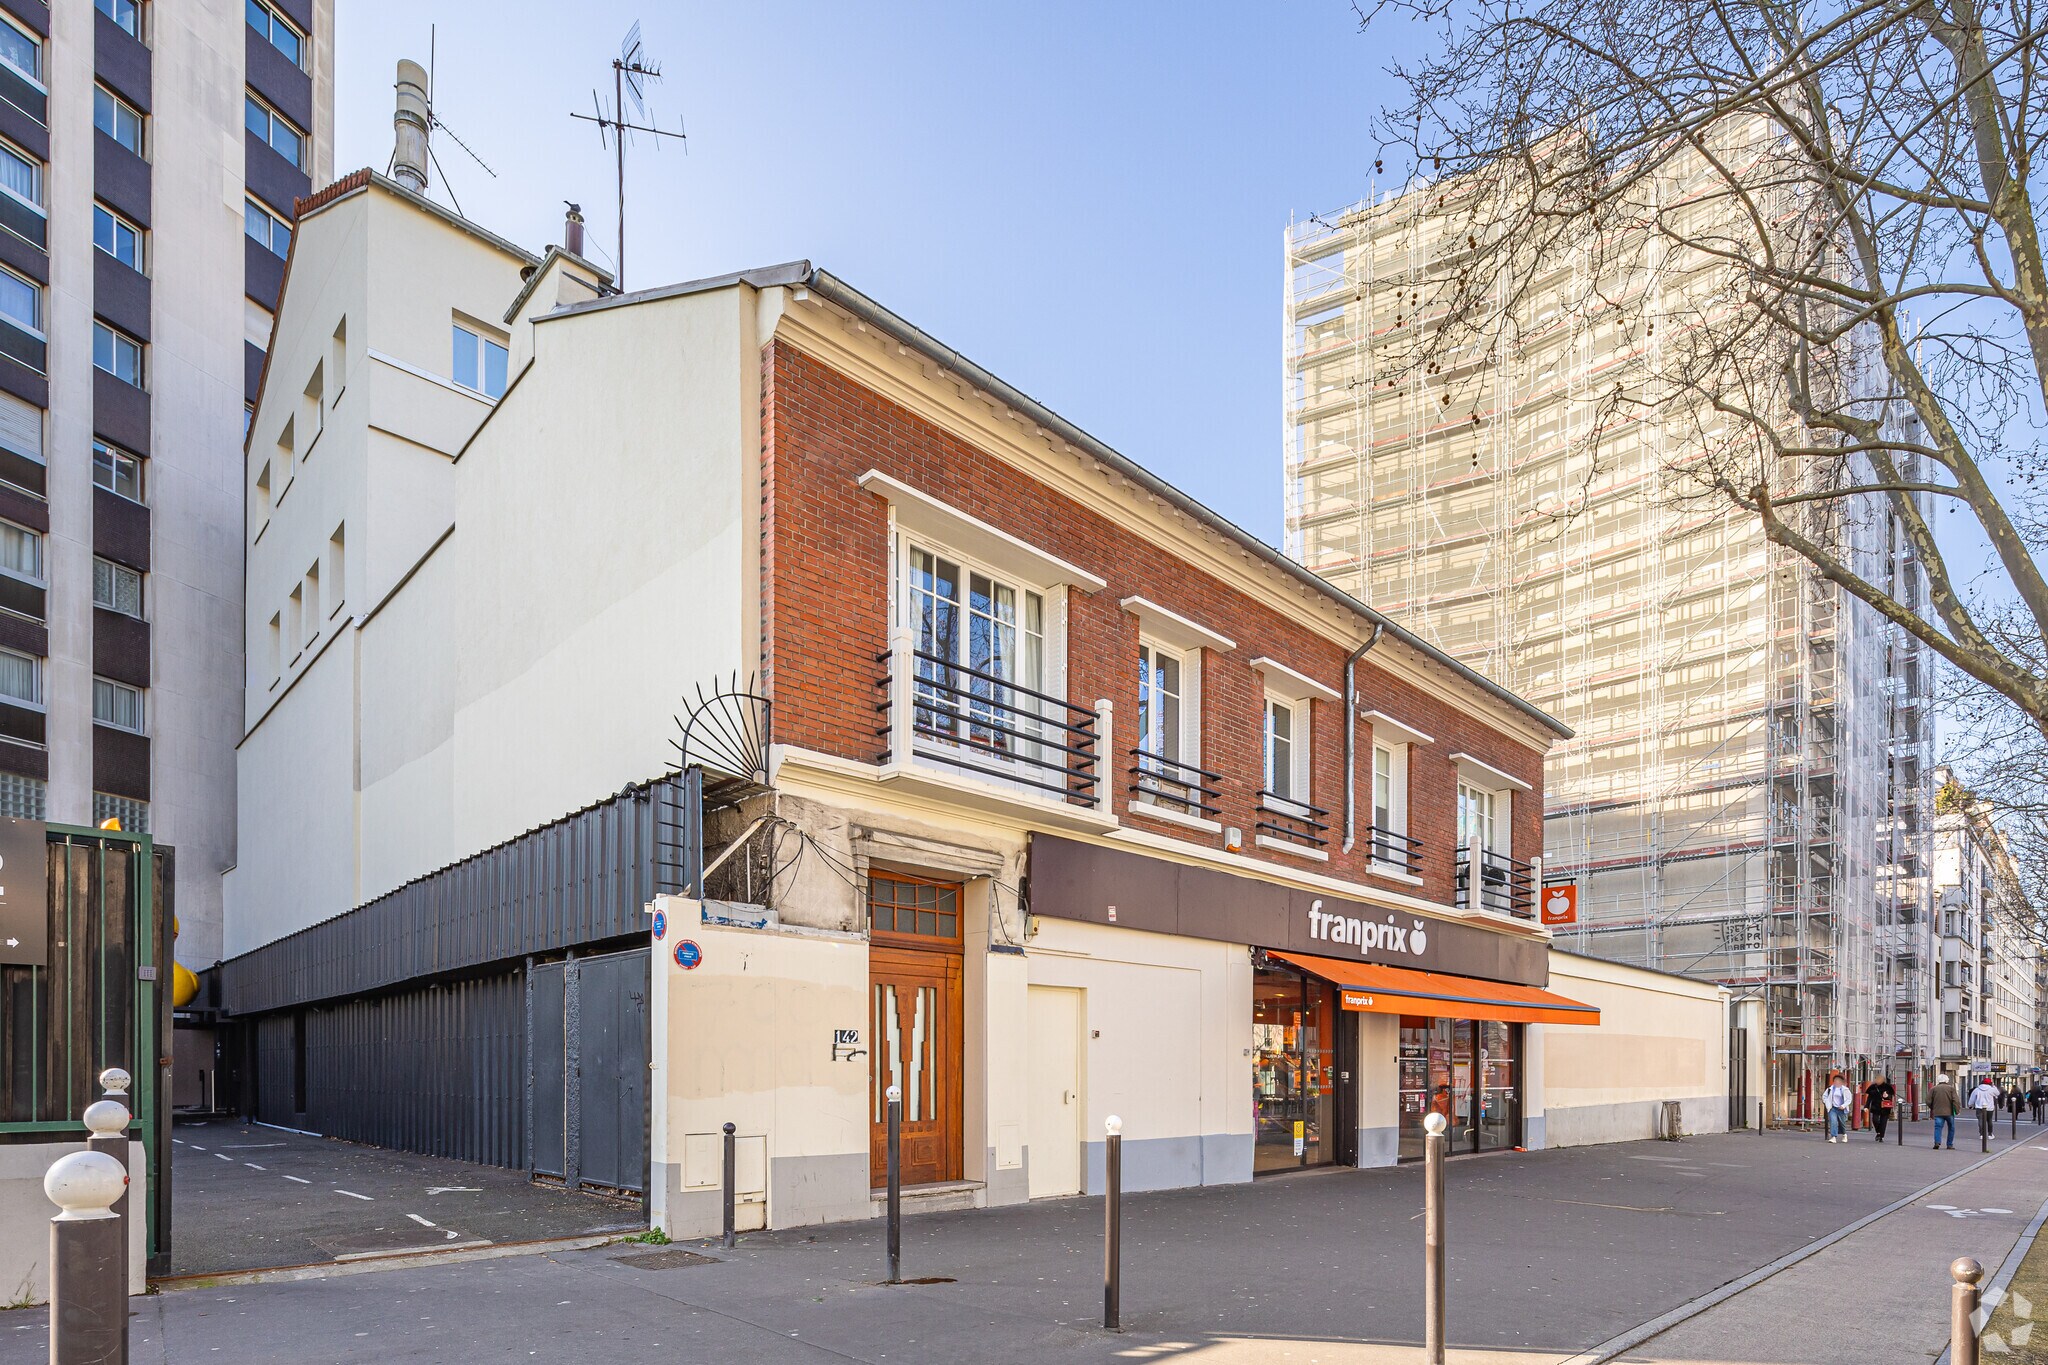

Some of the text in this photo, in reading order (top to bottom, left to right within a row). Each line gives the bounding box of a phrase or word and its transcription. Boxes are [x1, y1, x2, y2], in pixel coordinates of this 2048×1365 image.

[1308, 899, 1407, 955] franprix
[1345, 994, 1368, 1007] franprix
[835, 1030, 858, 1043] 142
